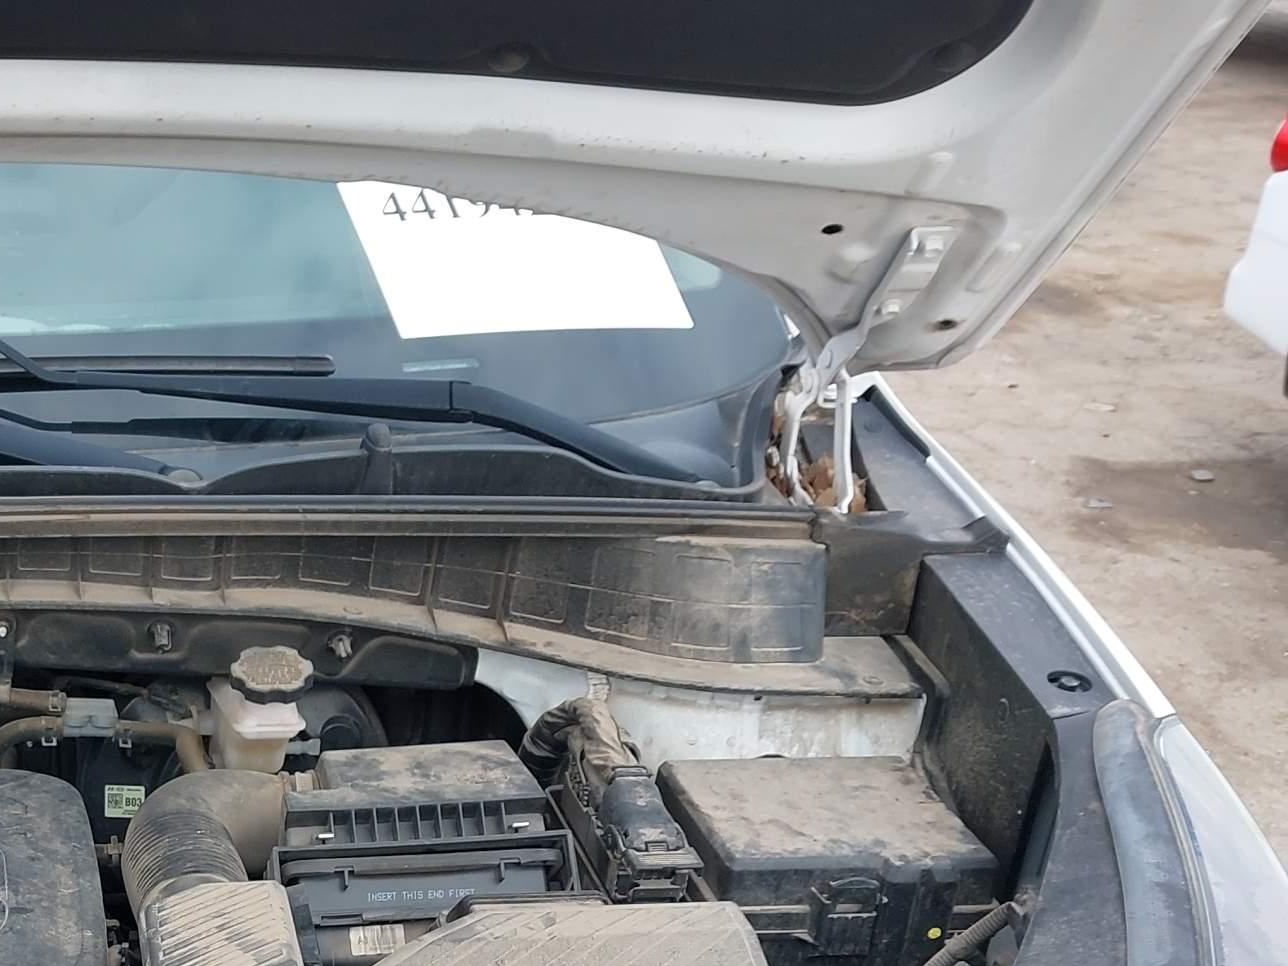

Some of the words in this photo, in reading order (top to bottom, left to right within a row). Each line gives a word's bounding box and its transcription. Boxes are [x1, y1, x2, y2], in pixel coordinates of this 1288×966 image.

[367, 891, 396, 903] INSERT
[402, 890, 424, 901] THIS
[428, 889, 444, 899] END
